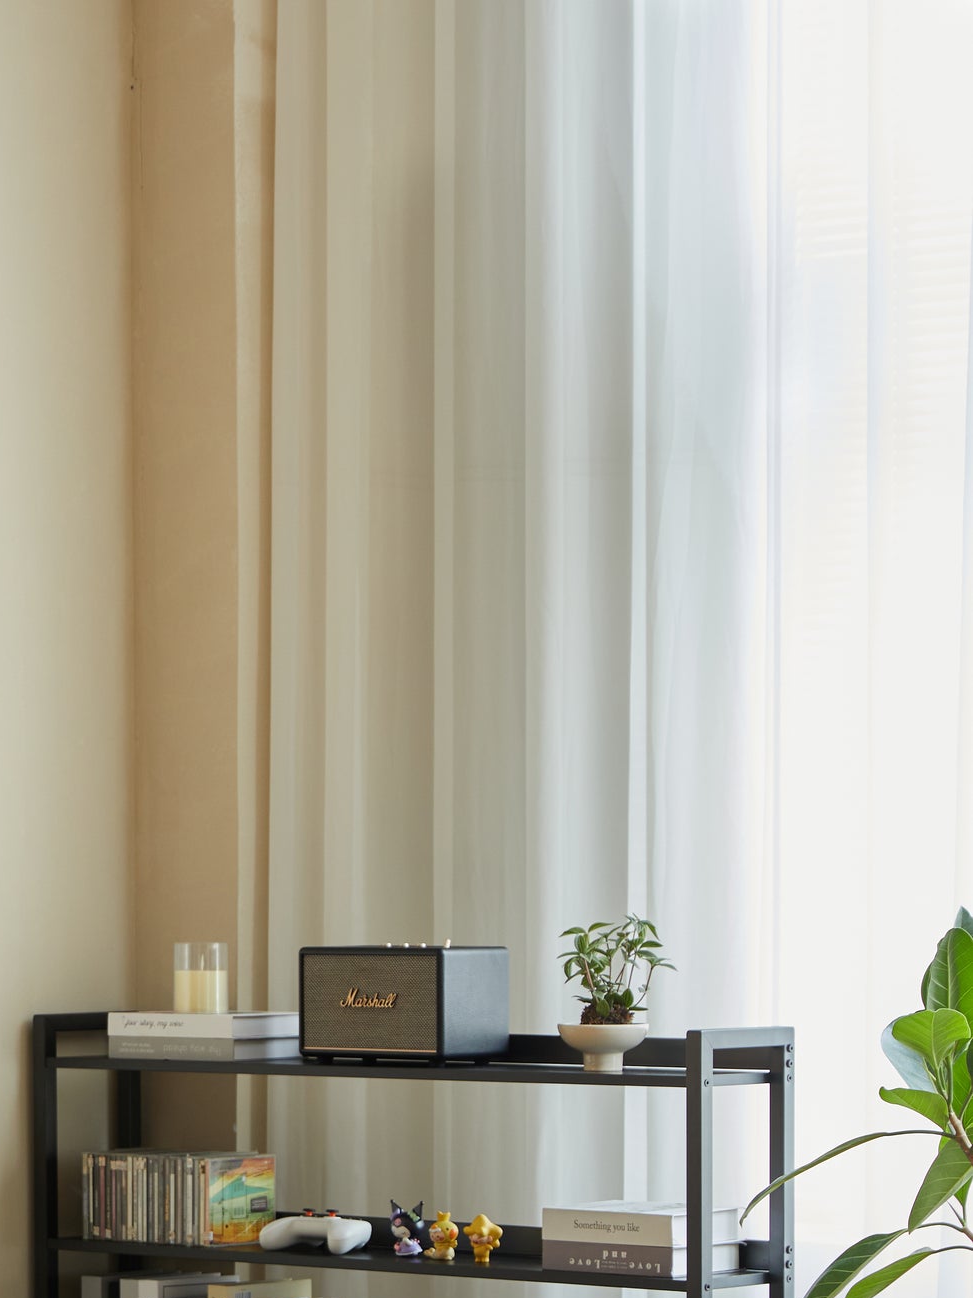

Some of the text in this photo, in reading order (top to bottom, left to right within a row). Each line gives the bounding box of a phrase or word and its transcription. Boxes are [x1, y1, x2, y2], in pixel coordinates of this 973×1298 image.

[340, 987, 397, 1009] Marshall
[573, 1219, 640, 1234] Something you like
[602, 1249, 628, 1260] and
[569, 1257, 601, 1270] Love
[629, 1261, 661, 1273] Love
